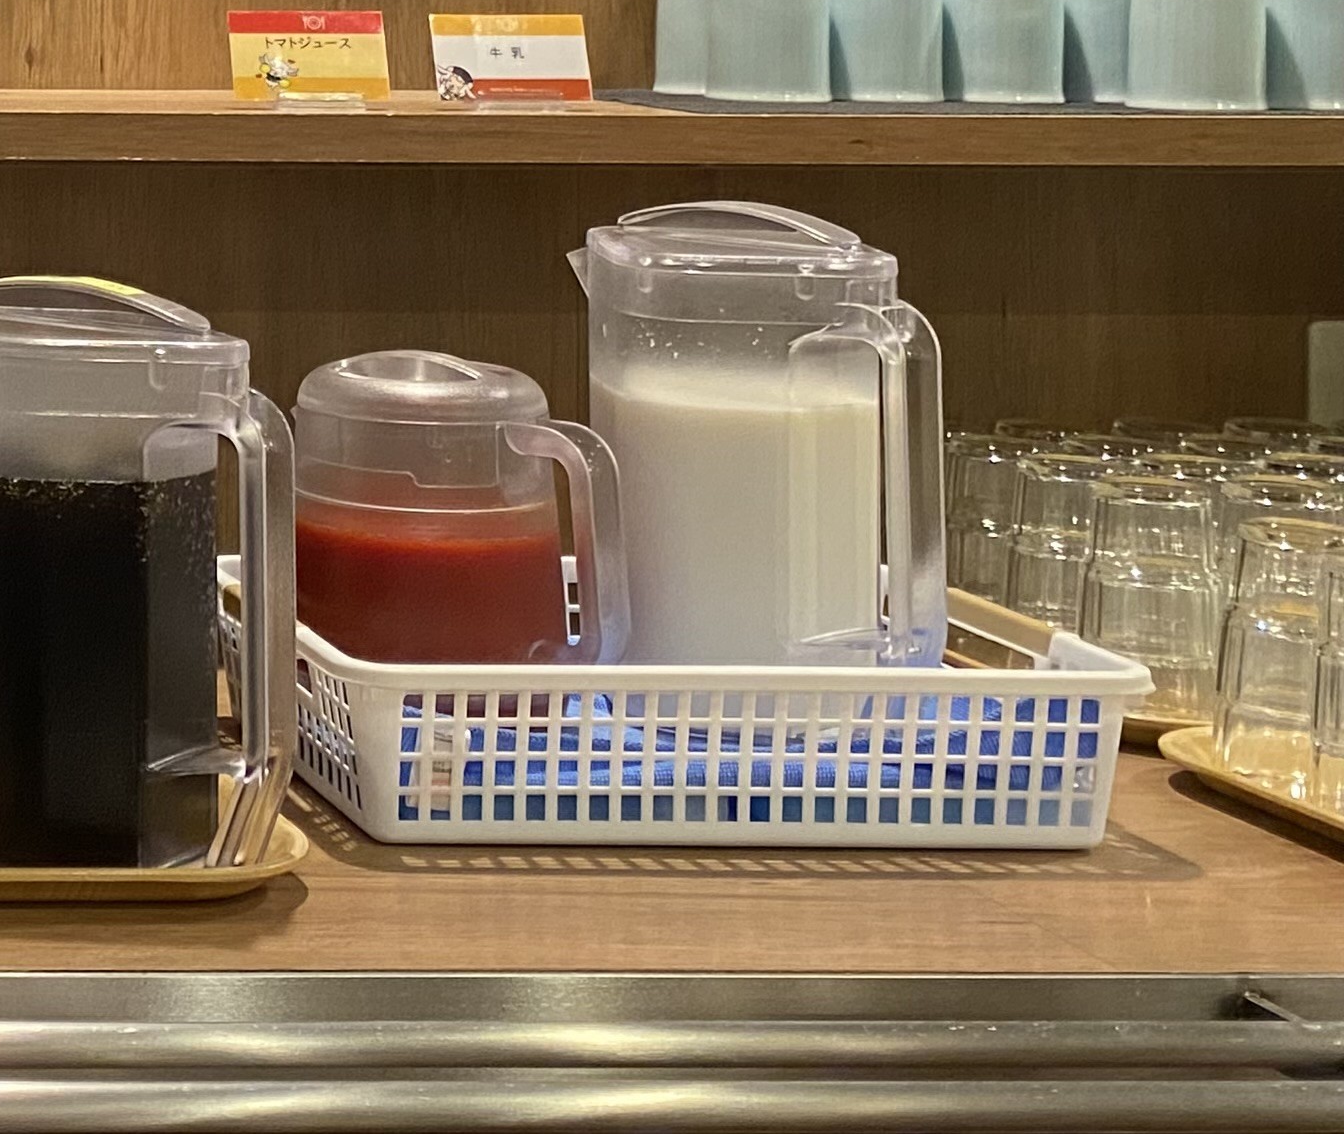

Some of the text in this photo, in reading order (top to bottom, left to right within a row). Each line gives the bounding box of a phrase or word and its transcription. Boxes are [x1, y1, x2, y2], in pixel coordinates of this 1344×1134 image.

[264, 36, 352, 50] トマトジュース
